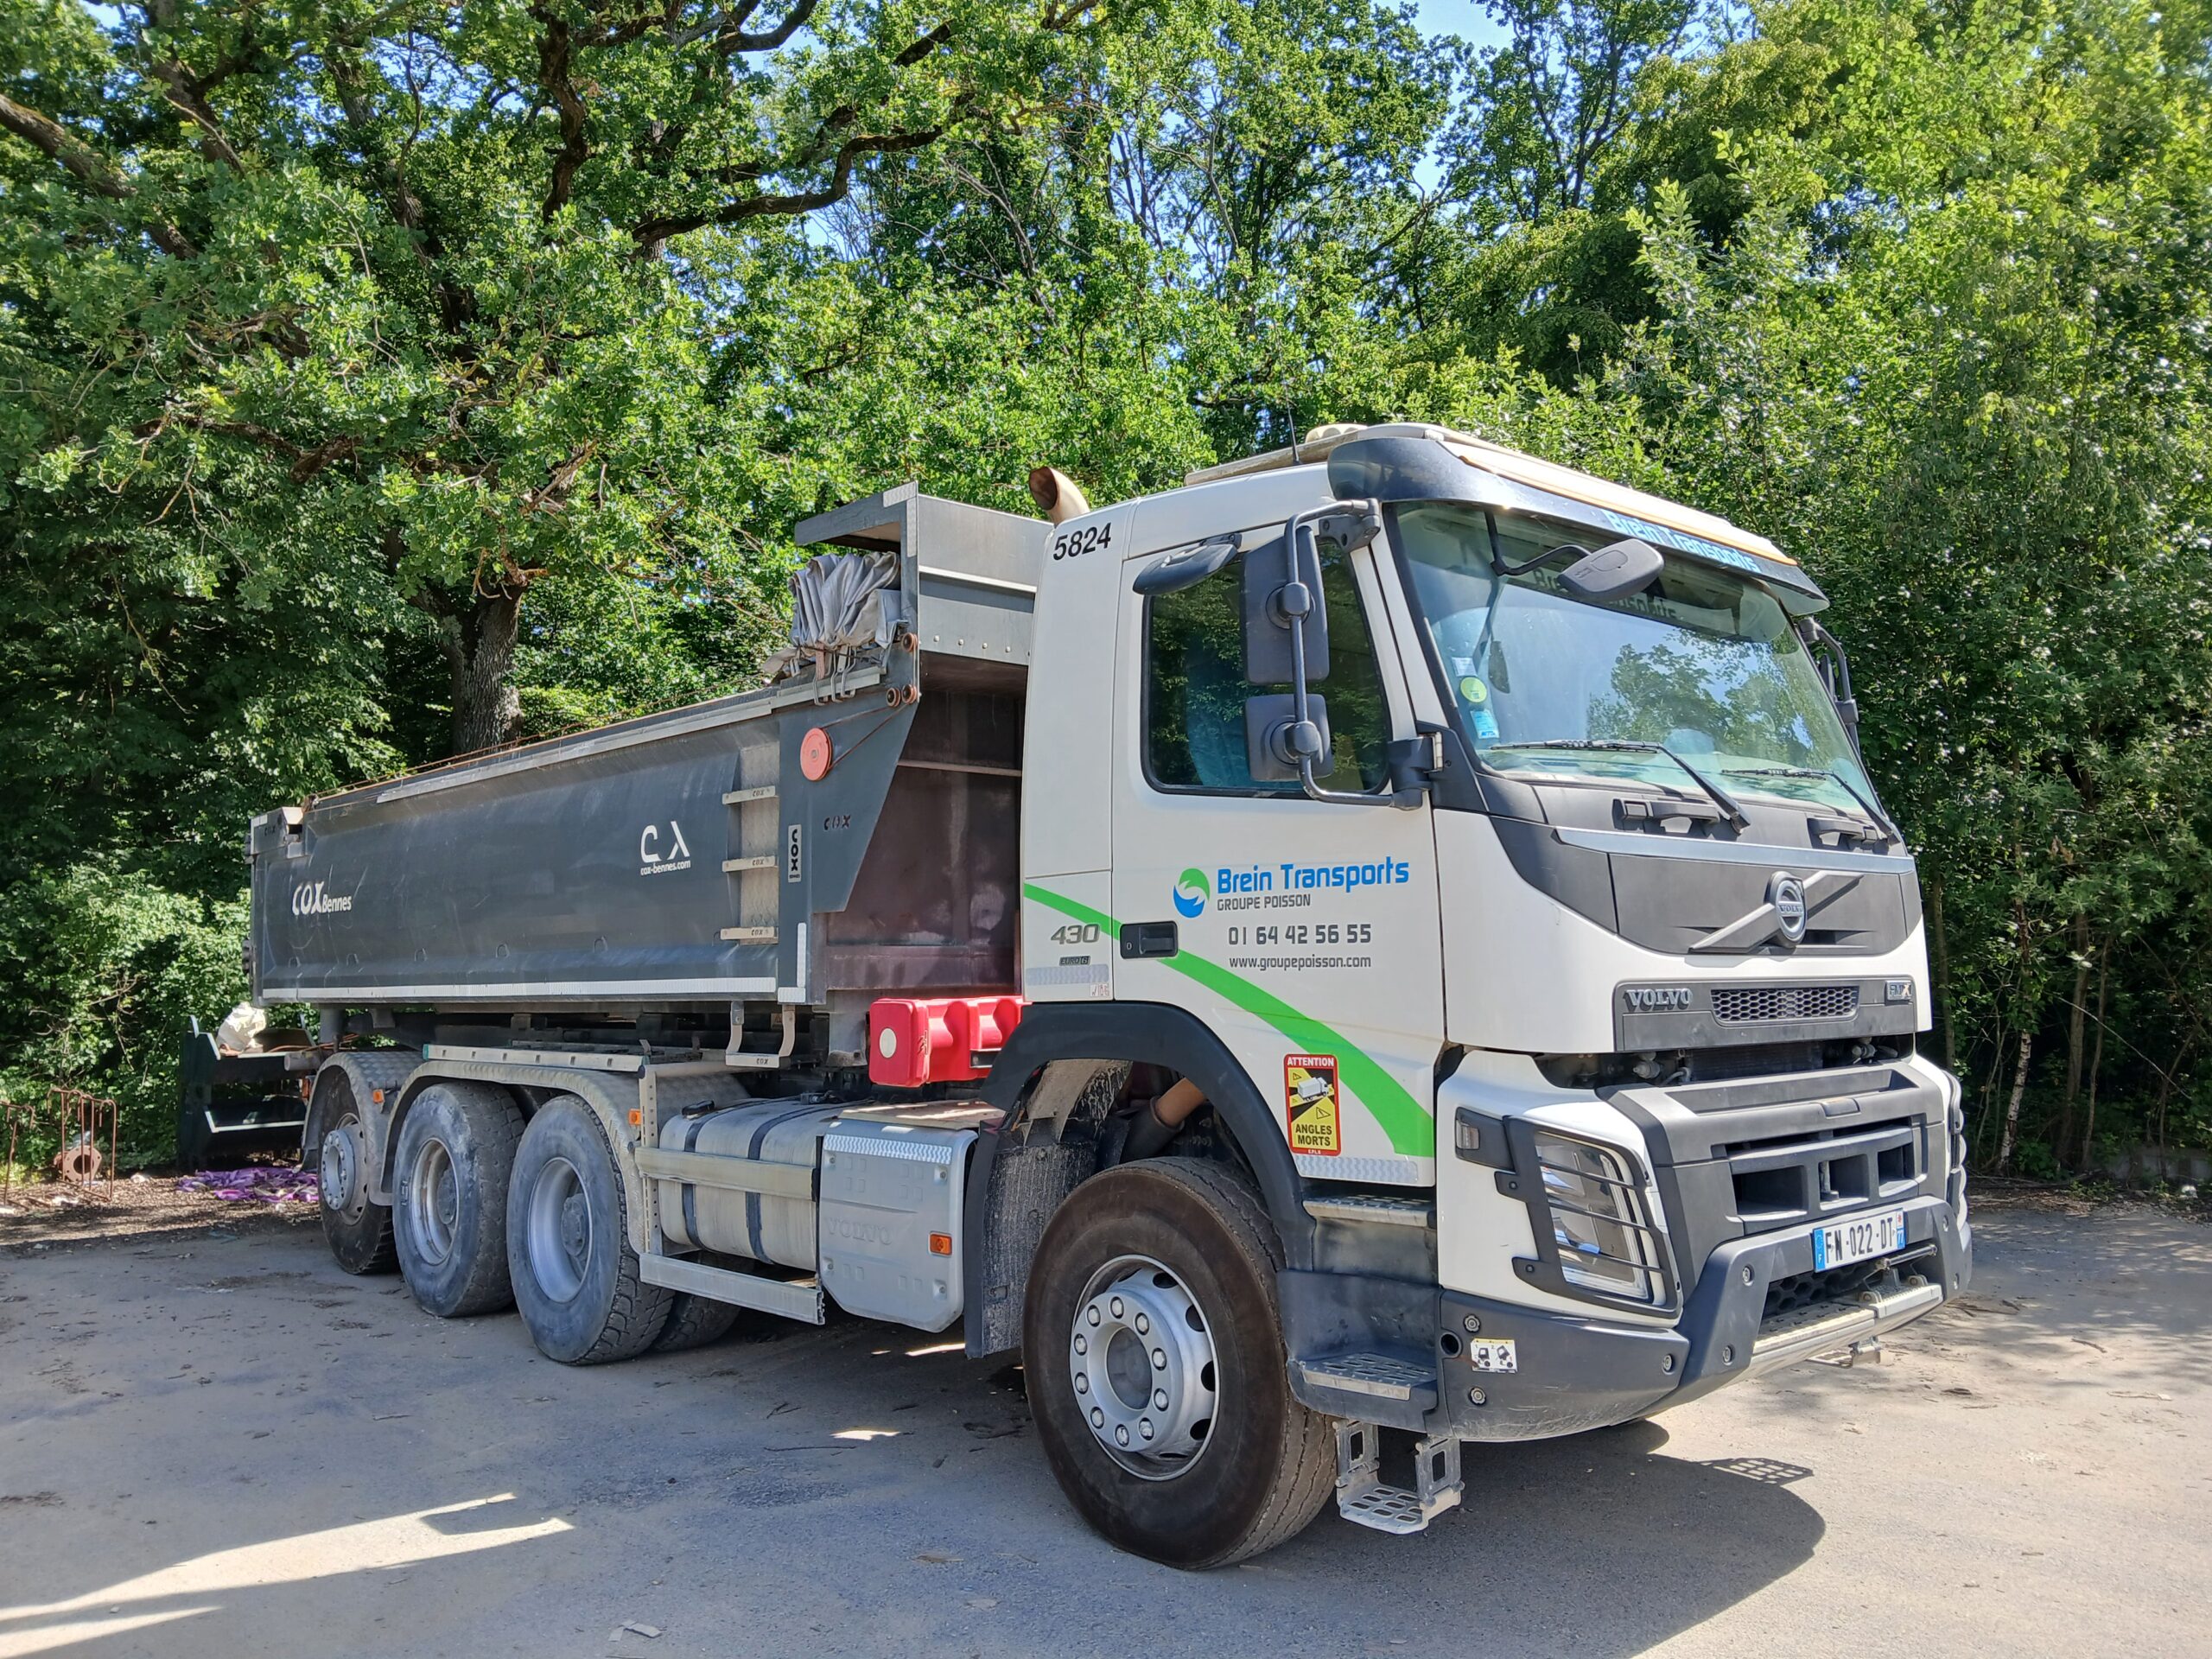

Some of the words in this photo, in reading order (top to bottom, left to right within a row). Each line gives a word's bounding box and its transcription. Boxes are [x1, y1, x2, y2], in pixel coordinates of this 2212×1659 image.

[1053, 522, 1111, 561] 5824
[790, 829, 799, 871] COX
[1217, 865, 1272, 894] Brein
[1280, 856, 1409, 893] Transports
[292, 881, 325, 915] COX
[321, 893, 353, 913] Bennes
[1217, 896, 1260, 911] GROUPE
[1264, 893, 1311, 908] POISSON
[1051, 923, 1100, 944] 430
[1228, 927, 1247, 945] 01
[1256, 926, 1278, 944] 64
[1285, 925, 1307, 944] 42
[1315, 925, 1338, 944] 56
[1347, 924, 1371, 944] 55
[1229, 954, 1371, 971] www.groupepoisson.com
[1625, 988, 1693, 1007] VOLVO
[1287, 1057, 1334, 1067] ATTENTION
[1295, 1123, 1332, 1135] ANGLES
[1297, 1135, 1331, 1147] MORTS
